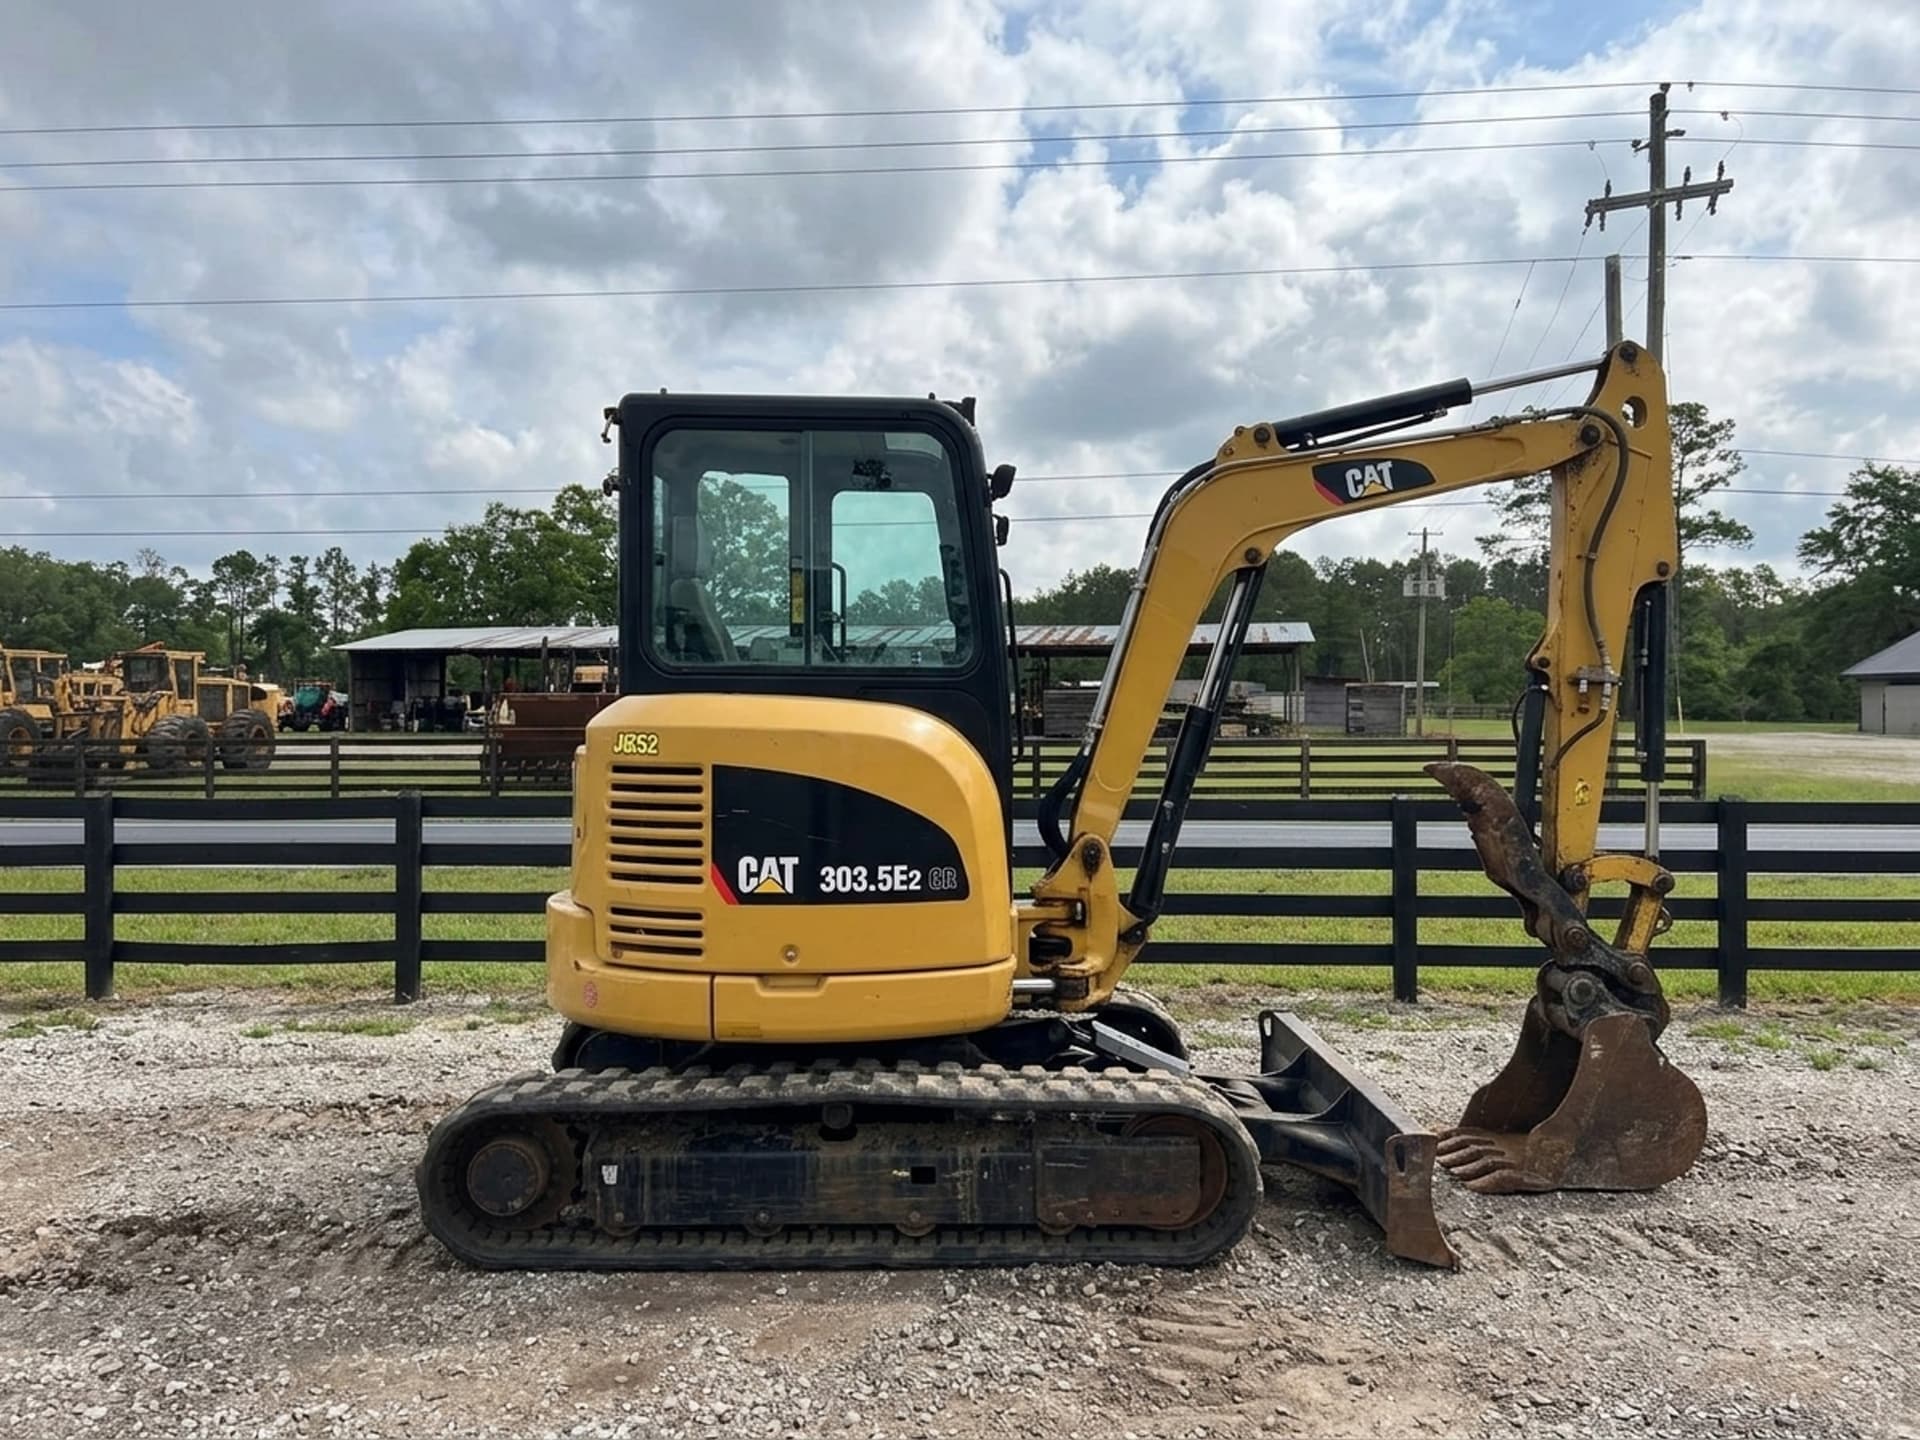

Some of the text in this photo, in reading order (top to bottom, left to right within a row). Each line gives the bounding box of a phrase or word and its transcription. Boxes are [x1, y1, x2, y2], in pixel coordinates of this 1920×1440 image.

[1345, 461, 1394, 499] CAT
[738, 855, 799, 894] CAT
[819, 864, 922, 893] 303.5E2
